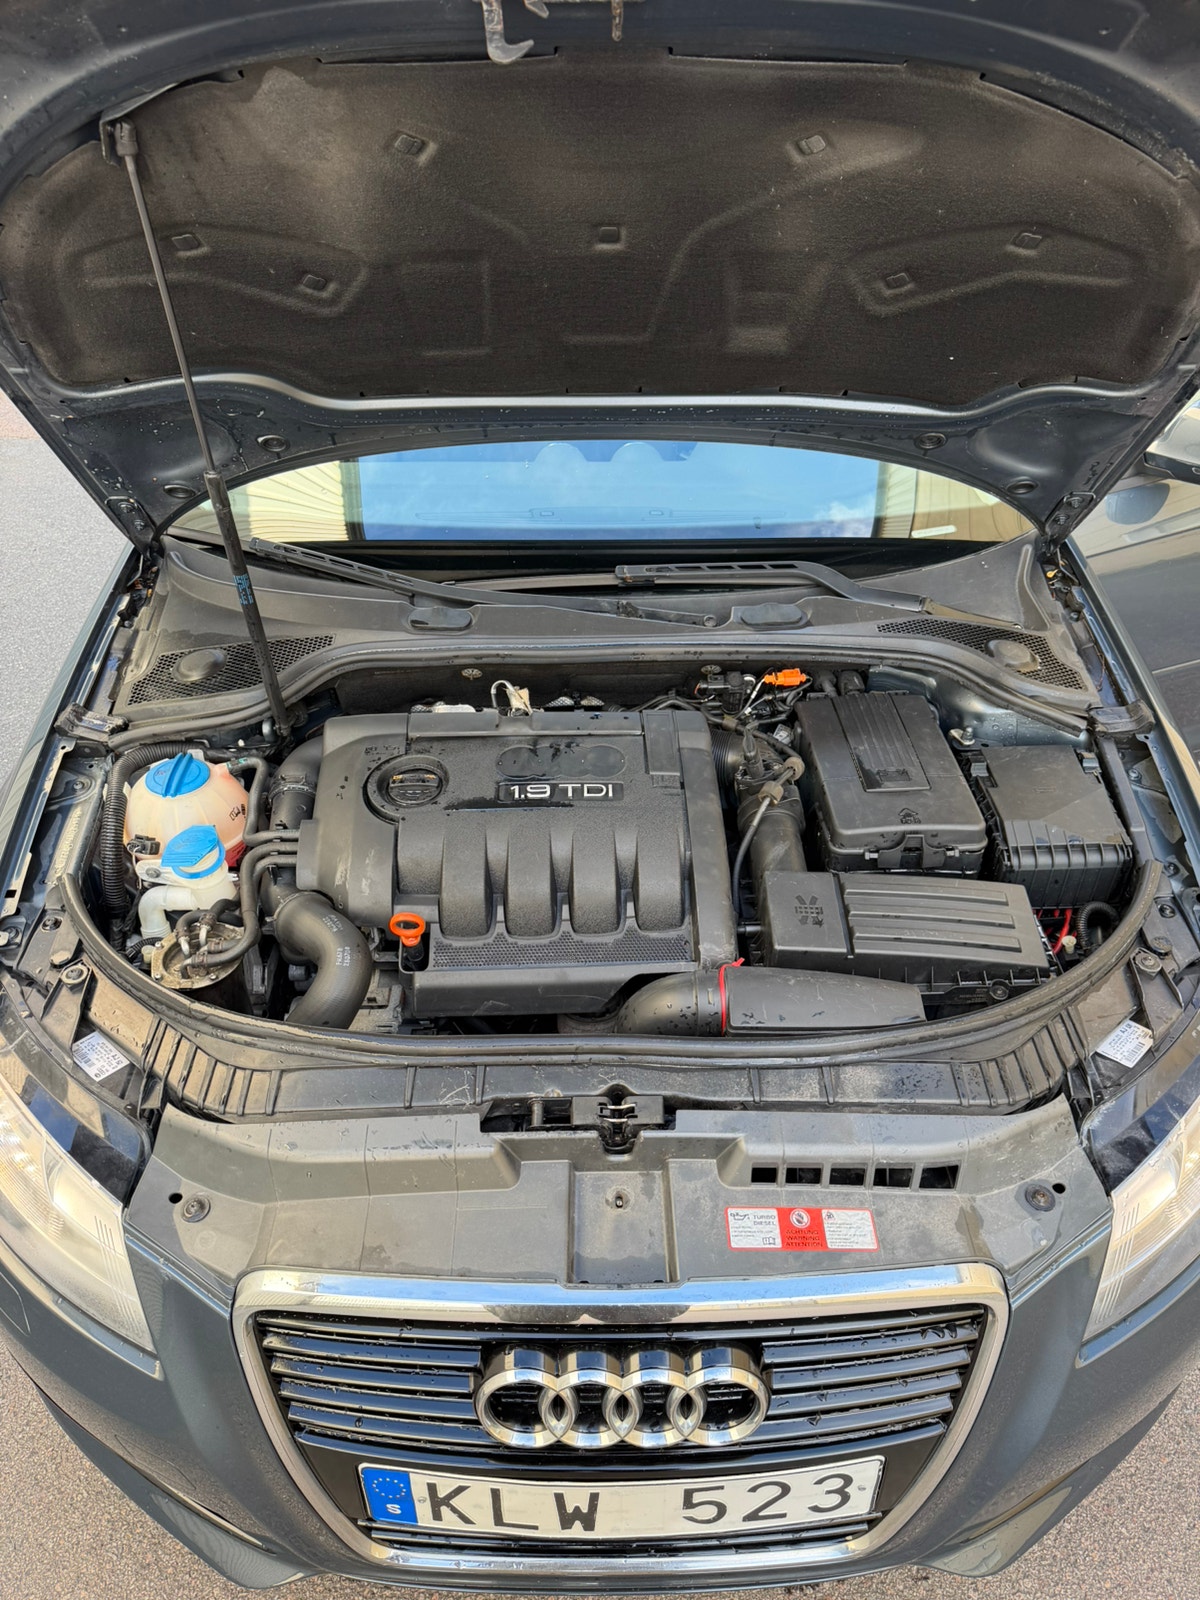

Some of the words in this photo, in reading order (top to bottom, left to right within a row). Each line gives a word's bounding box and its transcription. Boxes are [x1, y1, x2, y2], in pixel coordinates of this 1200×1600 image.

[510, 784, 551, 799] 1.9
[558, 783, 613, 798] TDI
[386, 1503, 402, 1514] S
[426, 1482, 600, 1532] KLW
[682, 1473, 854, 1525] 523
